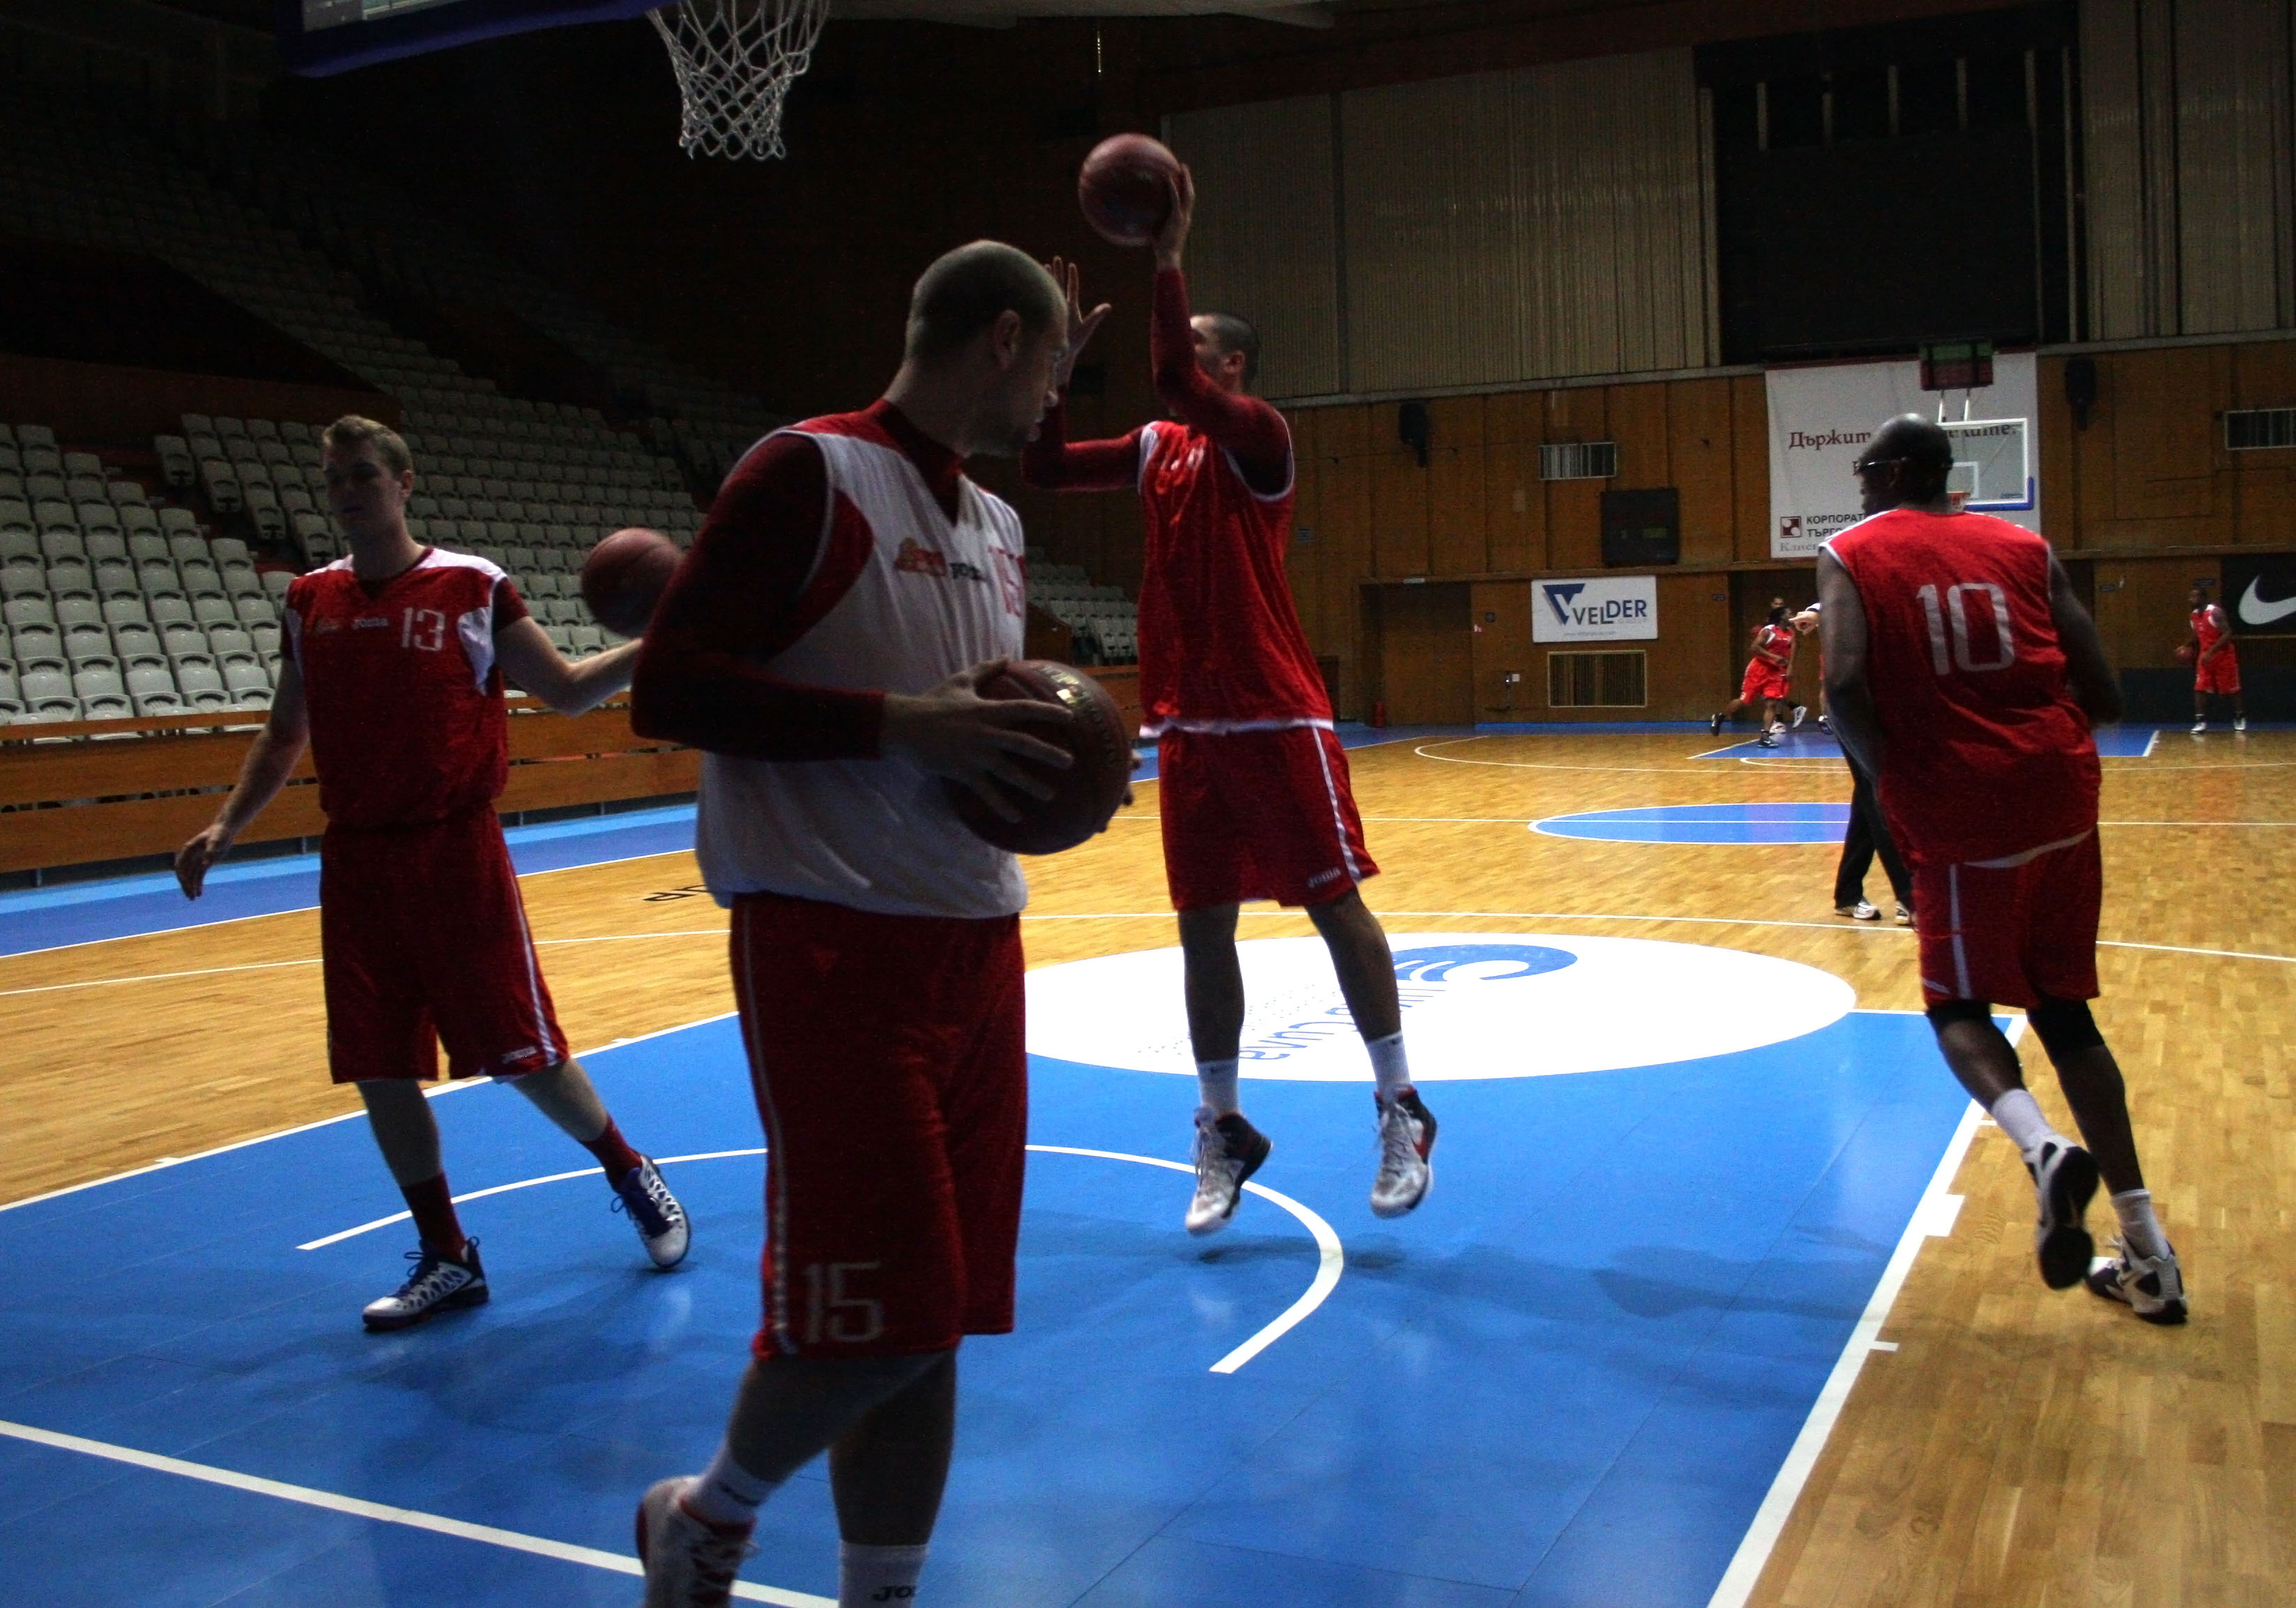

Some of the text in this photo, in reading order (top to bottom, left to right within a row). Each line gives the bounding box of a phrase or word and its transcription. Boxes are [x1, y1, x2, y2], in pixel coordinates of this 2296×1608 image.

[1789, 429, 1872, 451] Държит
[1807, 513, 1865, 524] КОРПОРАТ
[401, 606, 447, 652] 13
[1572, 599, 1647, 625] VELDER
[1916, 583, 2015, 675] 10
[802, 1259, 884, 1345] 15
